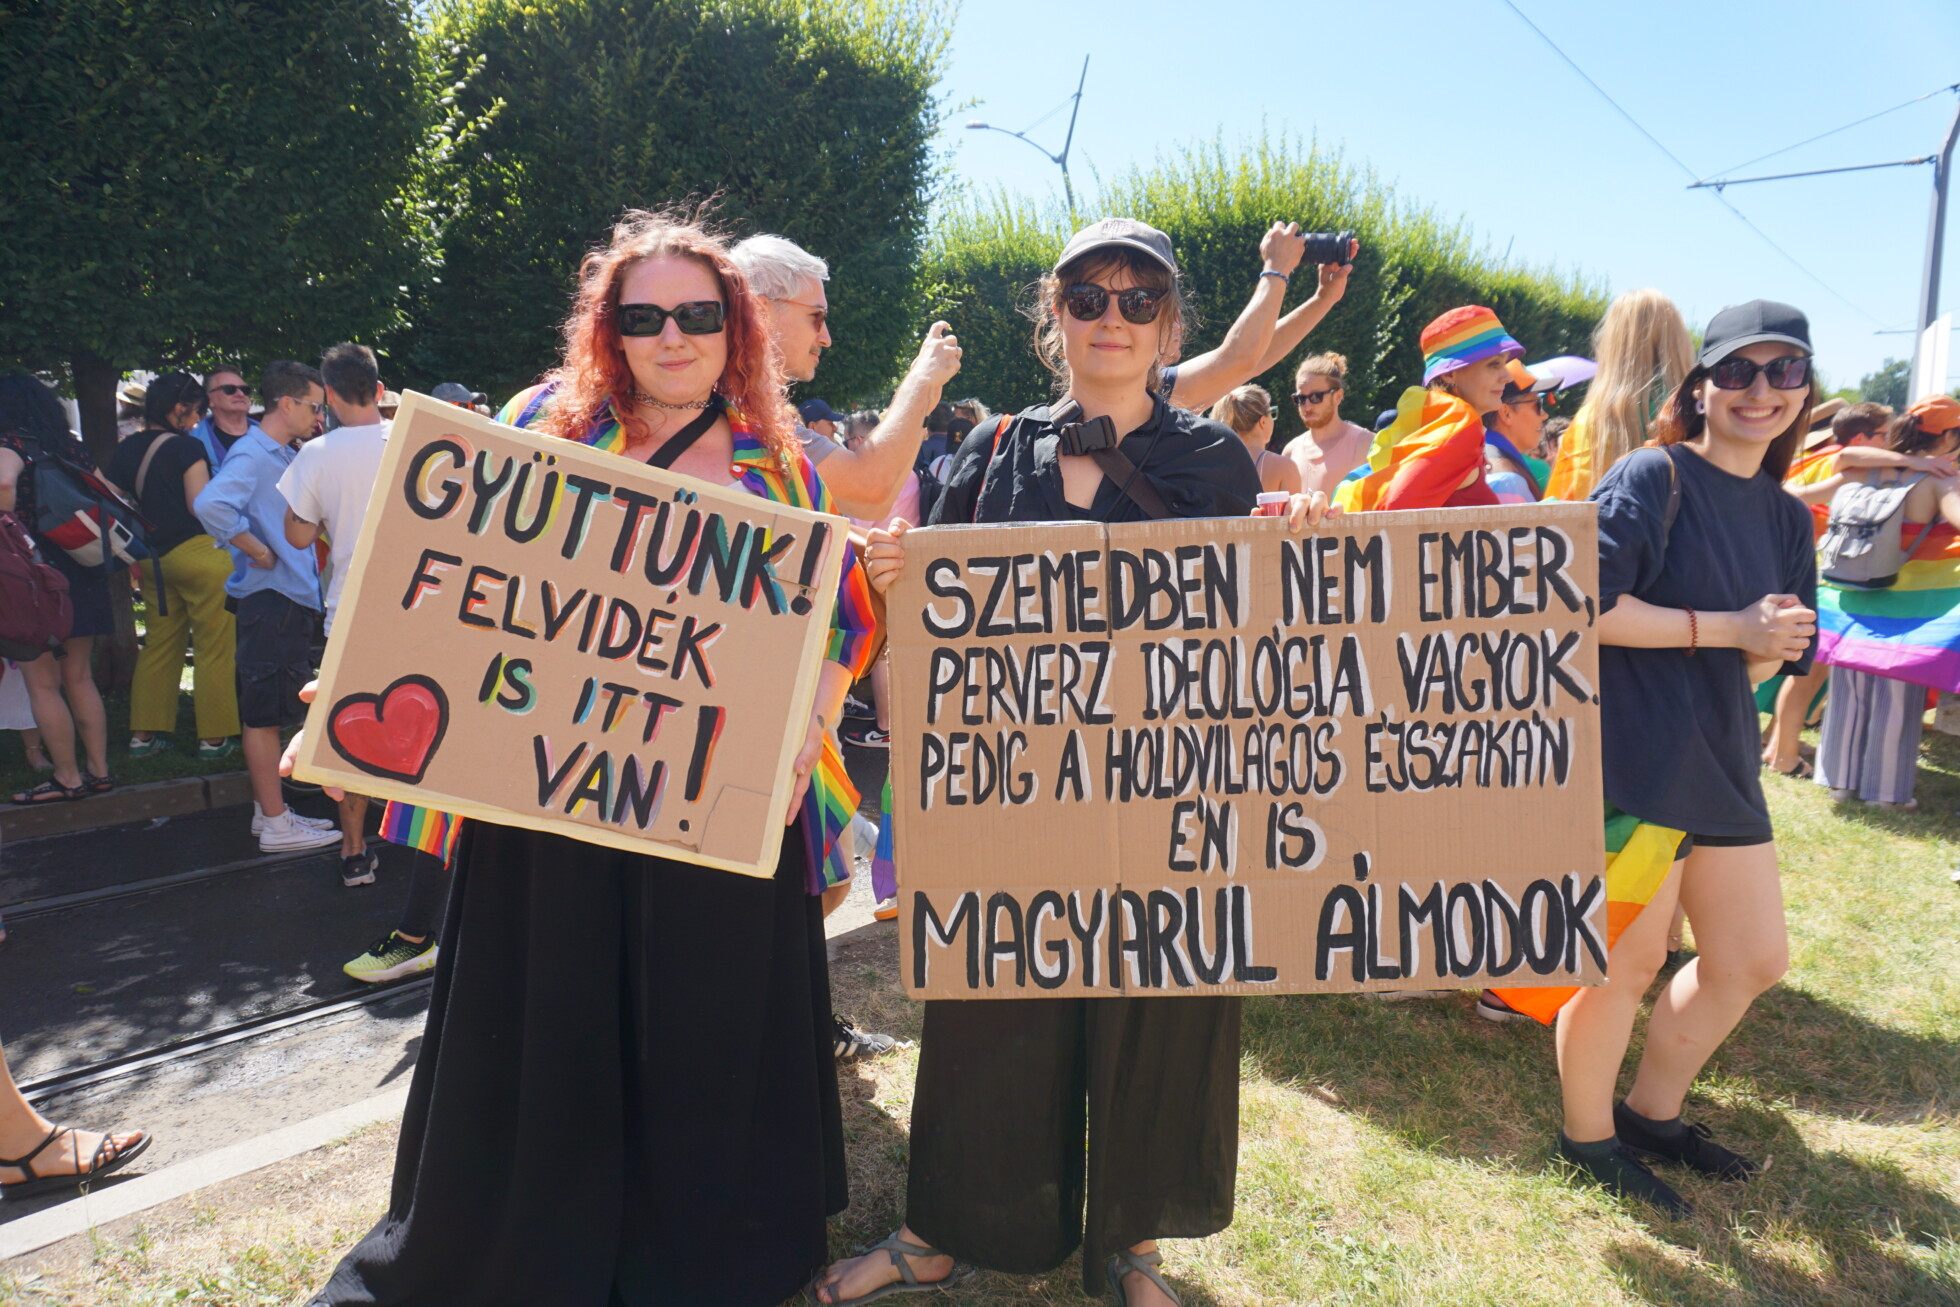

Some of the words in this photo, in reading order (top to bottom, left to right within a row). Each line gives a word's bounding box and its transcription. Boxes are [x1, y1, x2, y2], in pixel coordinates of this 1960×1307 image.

[404, 434, 832, 617] GYÜTTÜNK!
[401, 549, 727, 689] FELVIDÉK
[923, 538, 1250, 638] SZEMEDBEN
[1281, 531, 1390, 626] NEM
[1419, 526, 1595, 627] EMBER,
[478, 652, 536, 714] IS
[572, 677, 684, 744] ITT
[927, 640, 1116, 725] PERVERZ
[1140, 623, 1374, 720] IDEOLÓGIA
[1397, 628, 1599, 715] VAGYOK.
[533, 705, 727, 833] VAN!
[921, 726, 1039, 810] PEDIG
[1056, 728, 1091, 802] A
[1105, 715, 1346, 802] HOLDVILÁGOS
[1365, 705, 1573, 793] ÉJSZAKÁN
[1169, 793, 1238, 877] ÉN
[1266, 802, 1327, 872] IS
[913, 882, 1277, 990] MAGYARUL
[1315, 851, 1607, 981] ÁLMODOK
